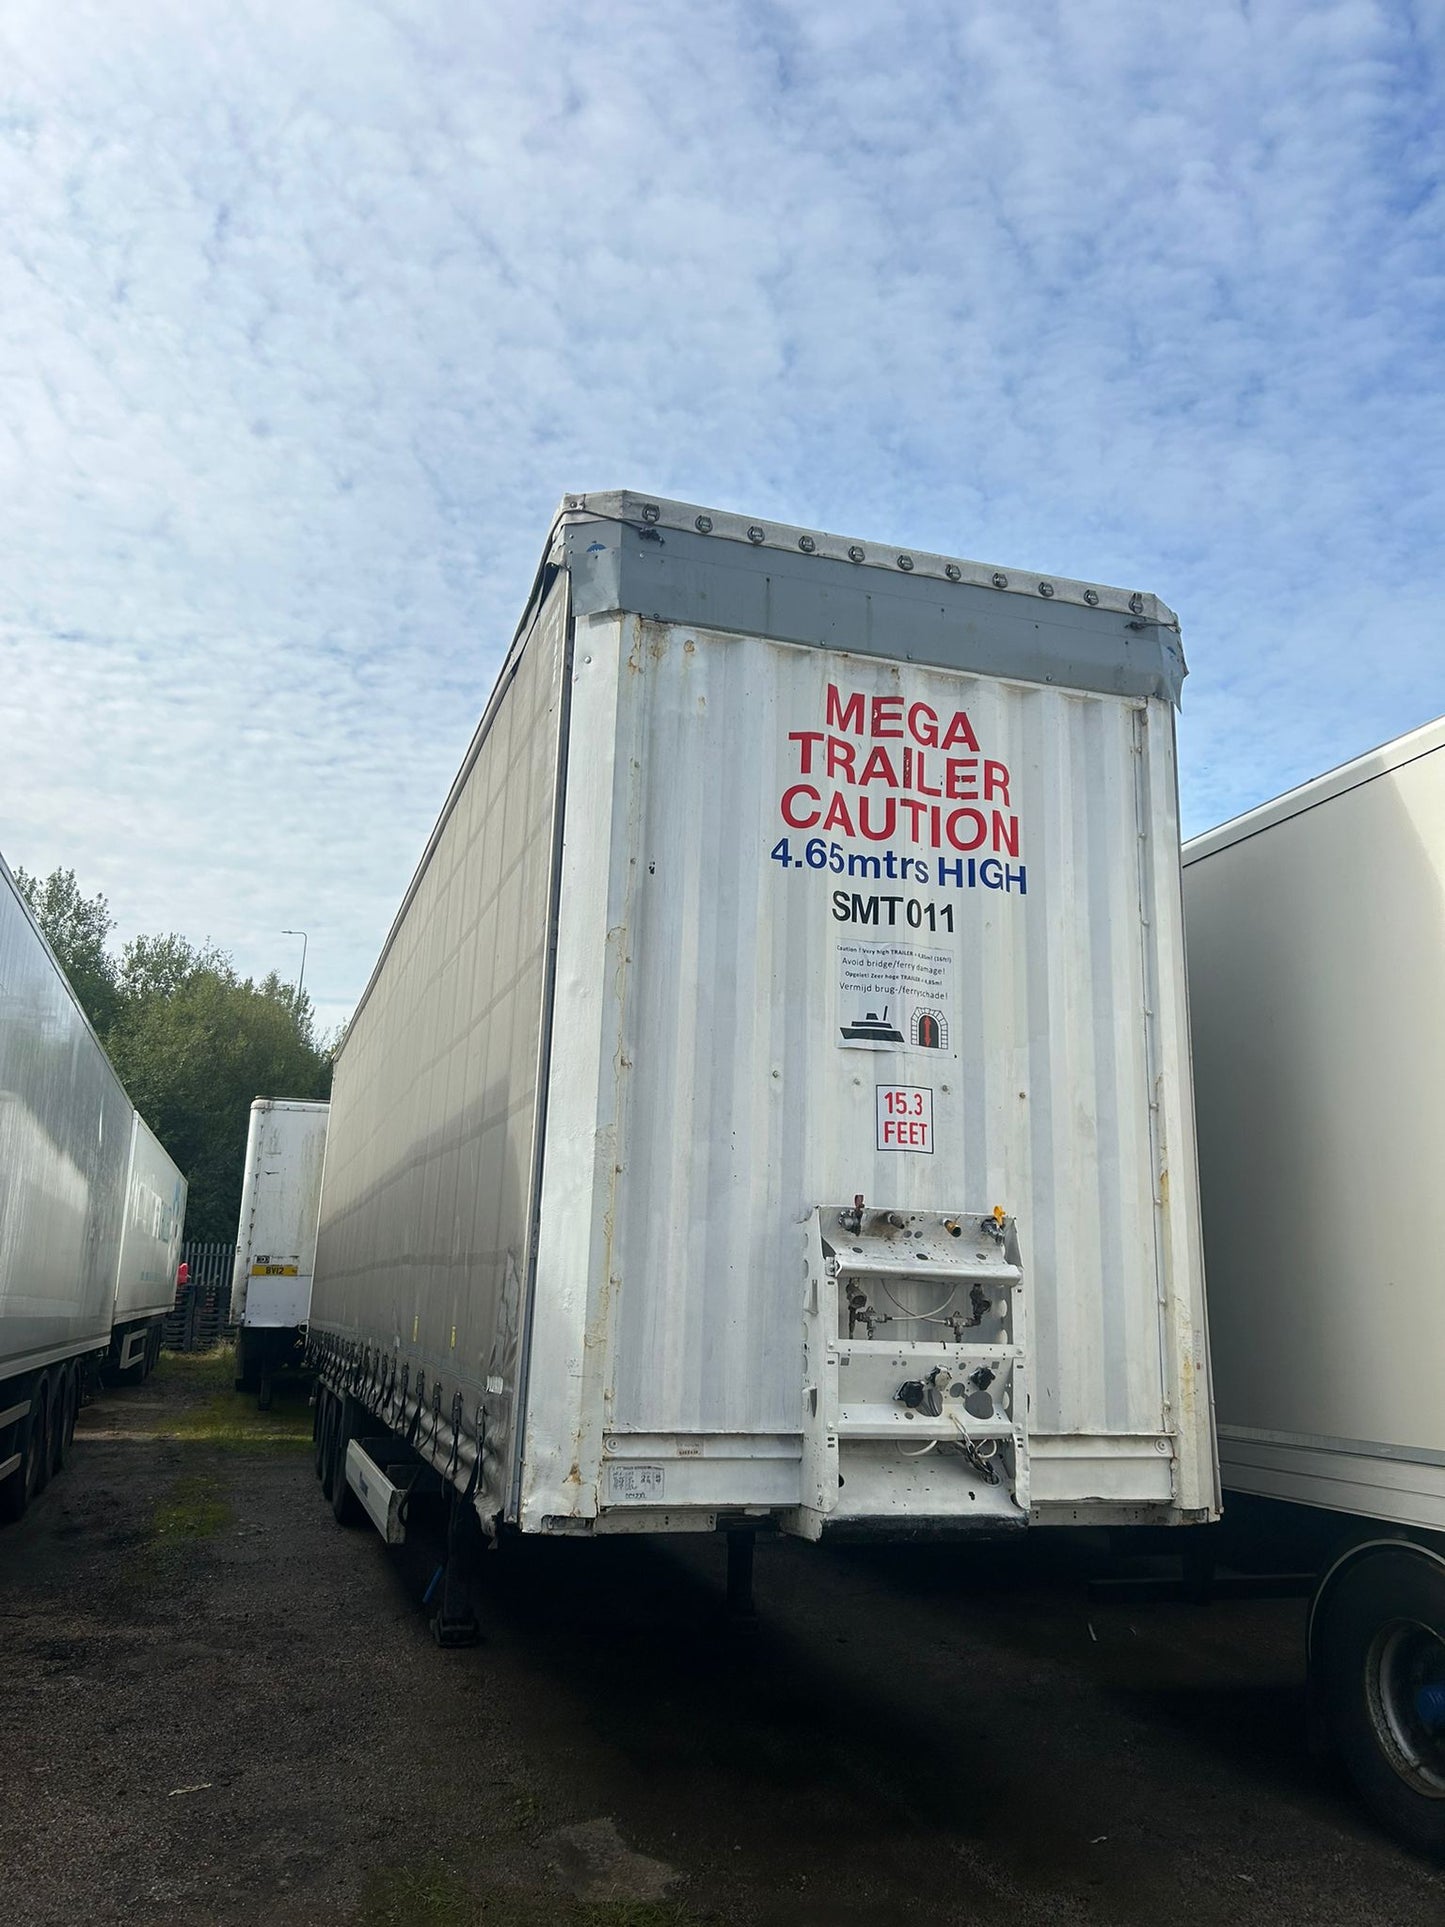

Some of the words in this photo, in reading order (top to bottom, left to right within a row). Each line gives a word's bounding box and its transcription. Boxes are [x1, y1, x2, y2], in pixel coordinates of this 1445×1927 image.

[826, 683, 981, 752] MEGA
[788, 731, 1011, 807] TRAILER
[780, 784, 1019, 858] CAUTION
[770, 838, 929, 884] 4.65mtrs
[938, 857, 1027, 895] HIGH
[837, 944, 857, 953] Caution
[862, 948, 875, 956] Very
[891, 949, 913, 957] TRAILER
[842, 957, 864, 967] Avoid
[867, 959, 915, 971] bridge/ferry
[916, 964, 946, 976] damage!
[901, 974, 920, 982] TRAILER
[839, 981, 872, 994] Vermijd
[875, 984, 948, 1001] brug-/ferryschade!
[884, 1091, 923, 1116] 15.3
[884, 1121, 928, 1146] FEET
